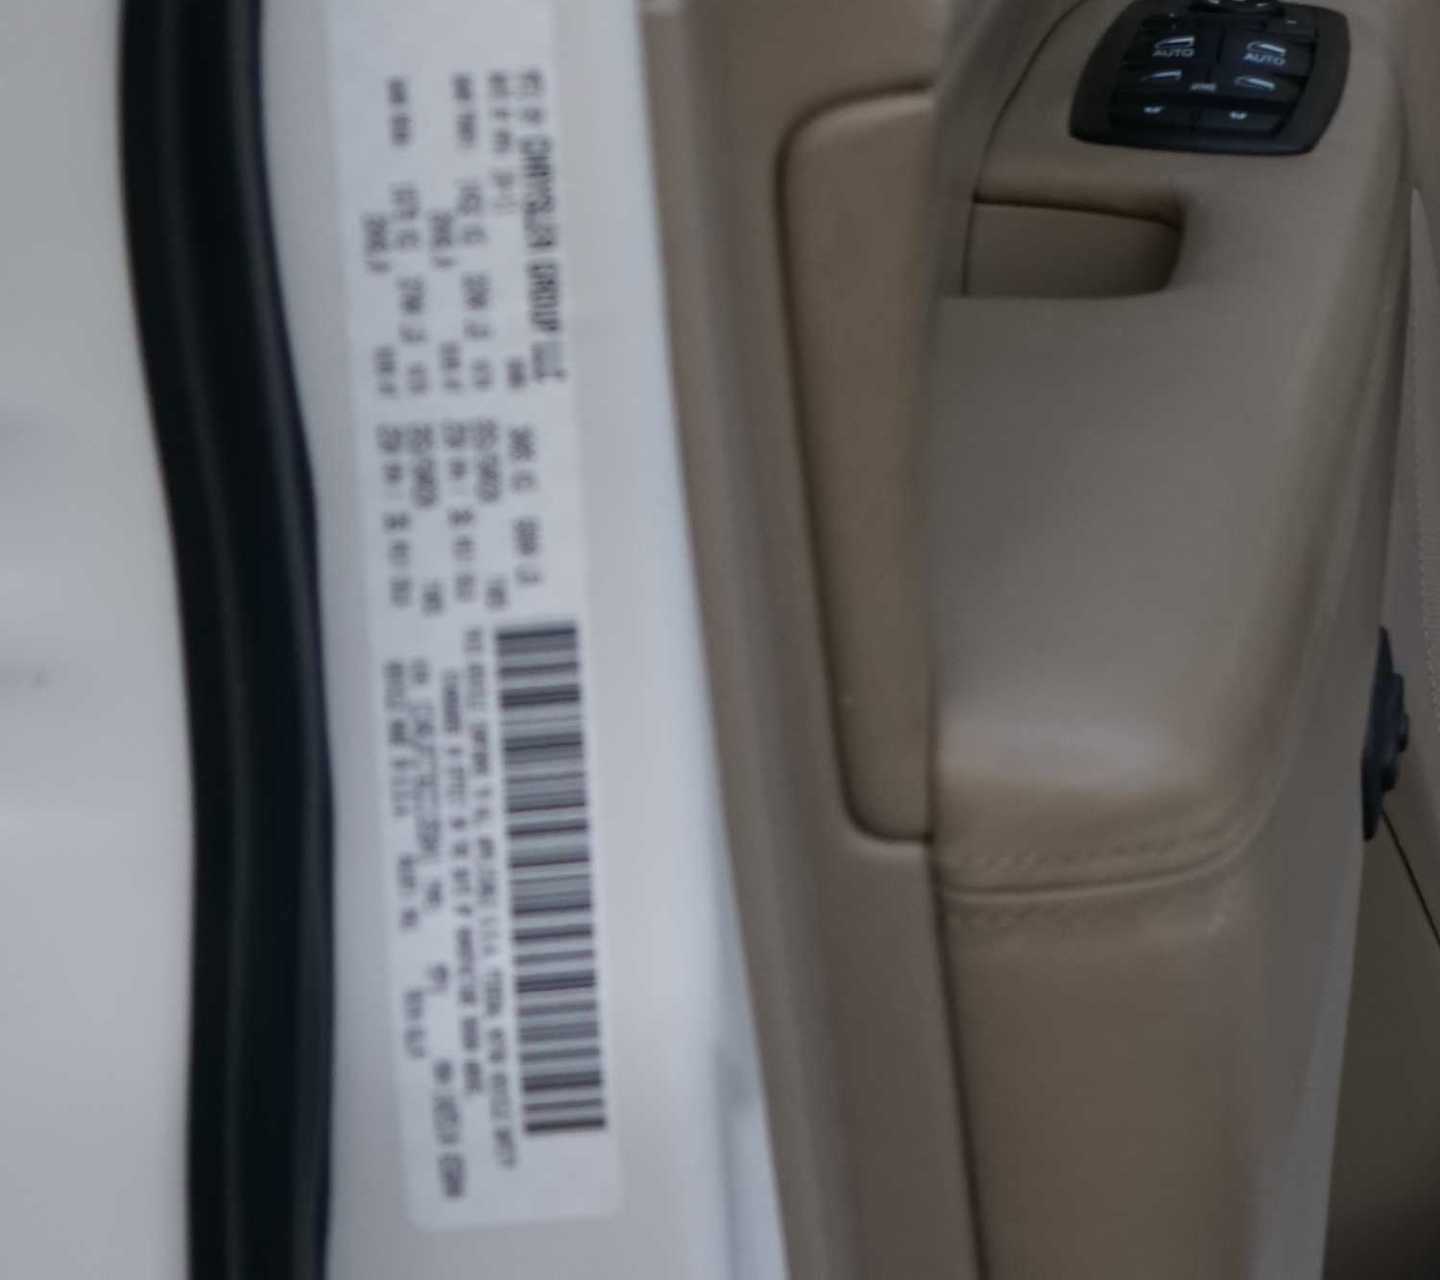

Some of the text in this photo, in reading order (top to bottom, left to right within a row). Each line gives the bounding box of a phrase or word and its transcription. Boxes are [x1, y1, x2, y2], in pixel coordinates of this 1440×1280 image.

[1152, 48, 1195, 58] AUTO
[1244, 52, 1286, 66] AUTO
[526, 260, 560, 333] GROUP
